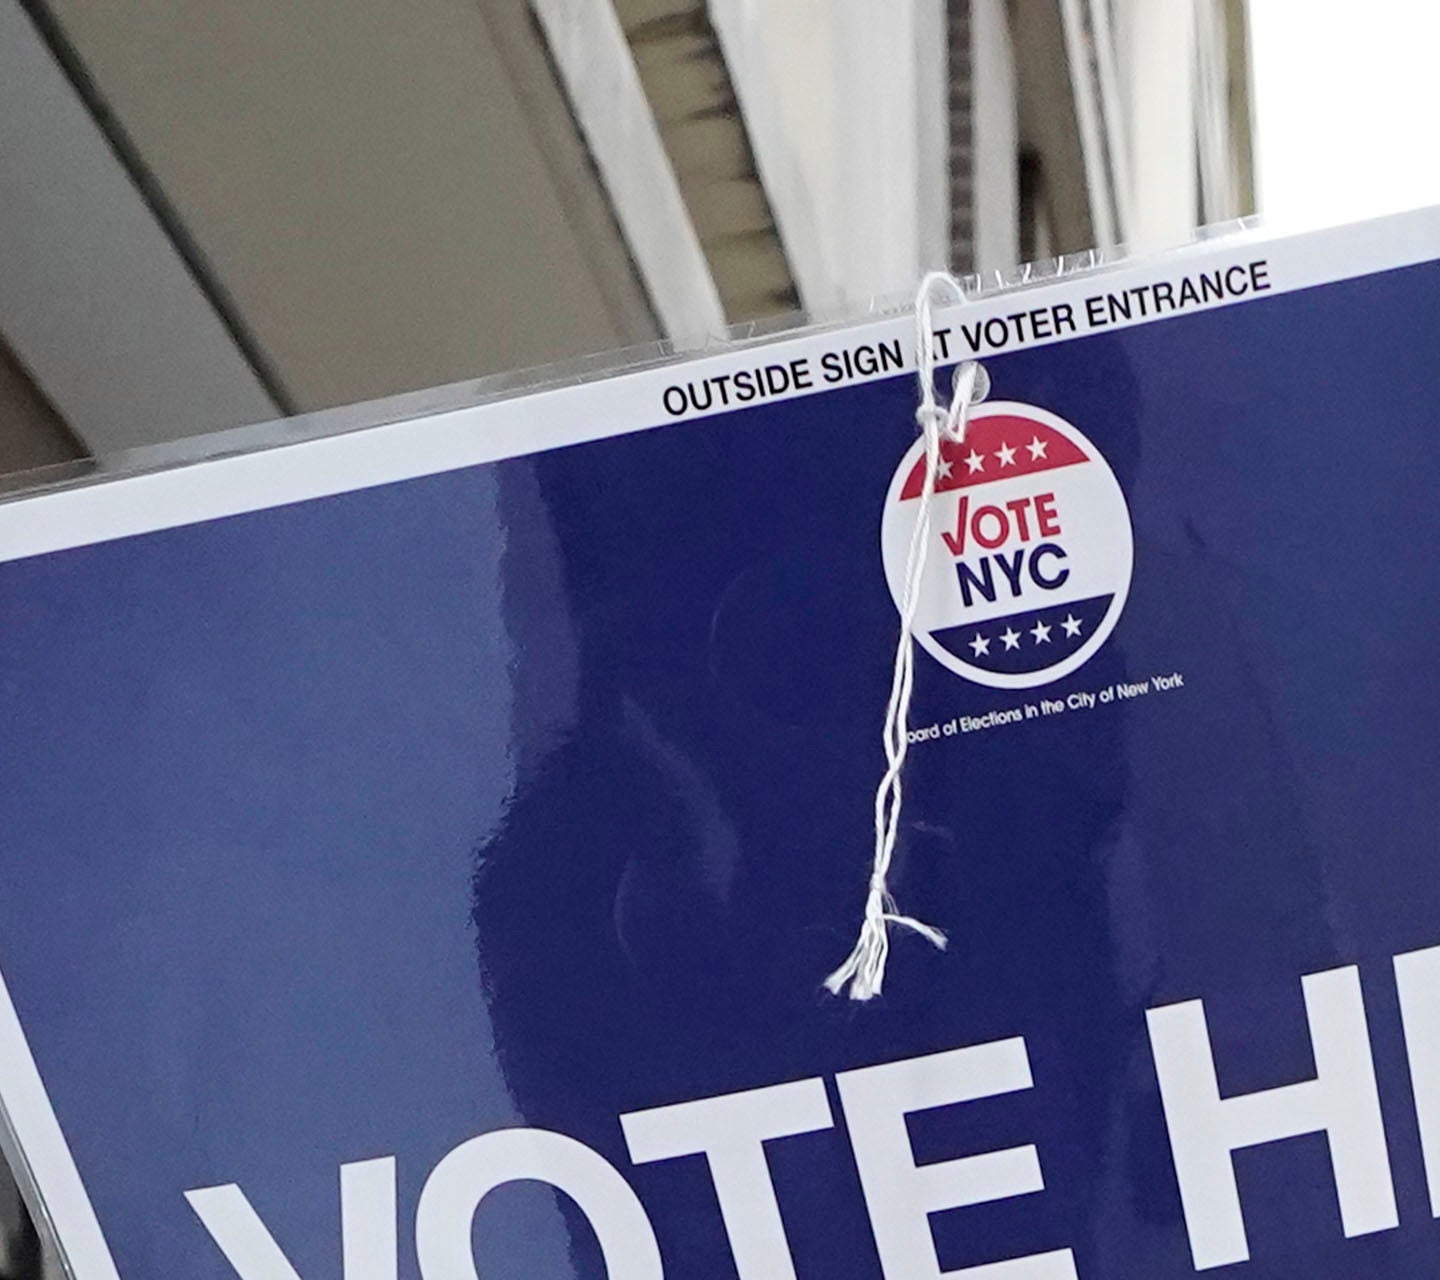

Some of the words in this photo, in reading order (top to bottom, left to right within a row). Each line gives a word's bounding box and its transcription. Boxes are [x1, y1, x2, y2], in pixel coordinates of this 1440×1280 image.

[662, 358, 814, 416] OUTSIDE
[820, 339, 905, 383] SIGN
[915, 327, 952, 362] T
[961, 302, 1077, 352] VOTER
[1085, 259, 1272, 327] ENTRANCE
[940, 492, 1062, 557] VOTE
[955, 542, 1071, 608] NYC
[904, 722, 940, 744] oard
[942, 719, 958, 737] of
[960, 705, 1023, 734] Elections
[1024, 702, 1039, 720] in
[1040, 698, 1065, 717] the
[1067, 690, 1097, 710] City
[1099, 686, 1114, 704] of
[1116, 681, 1150, 700] New
[1152, 672, 1185, 692] York
